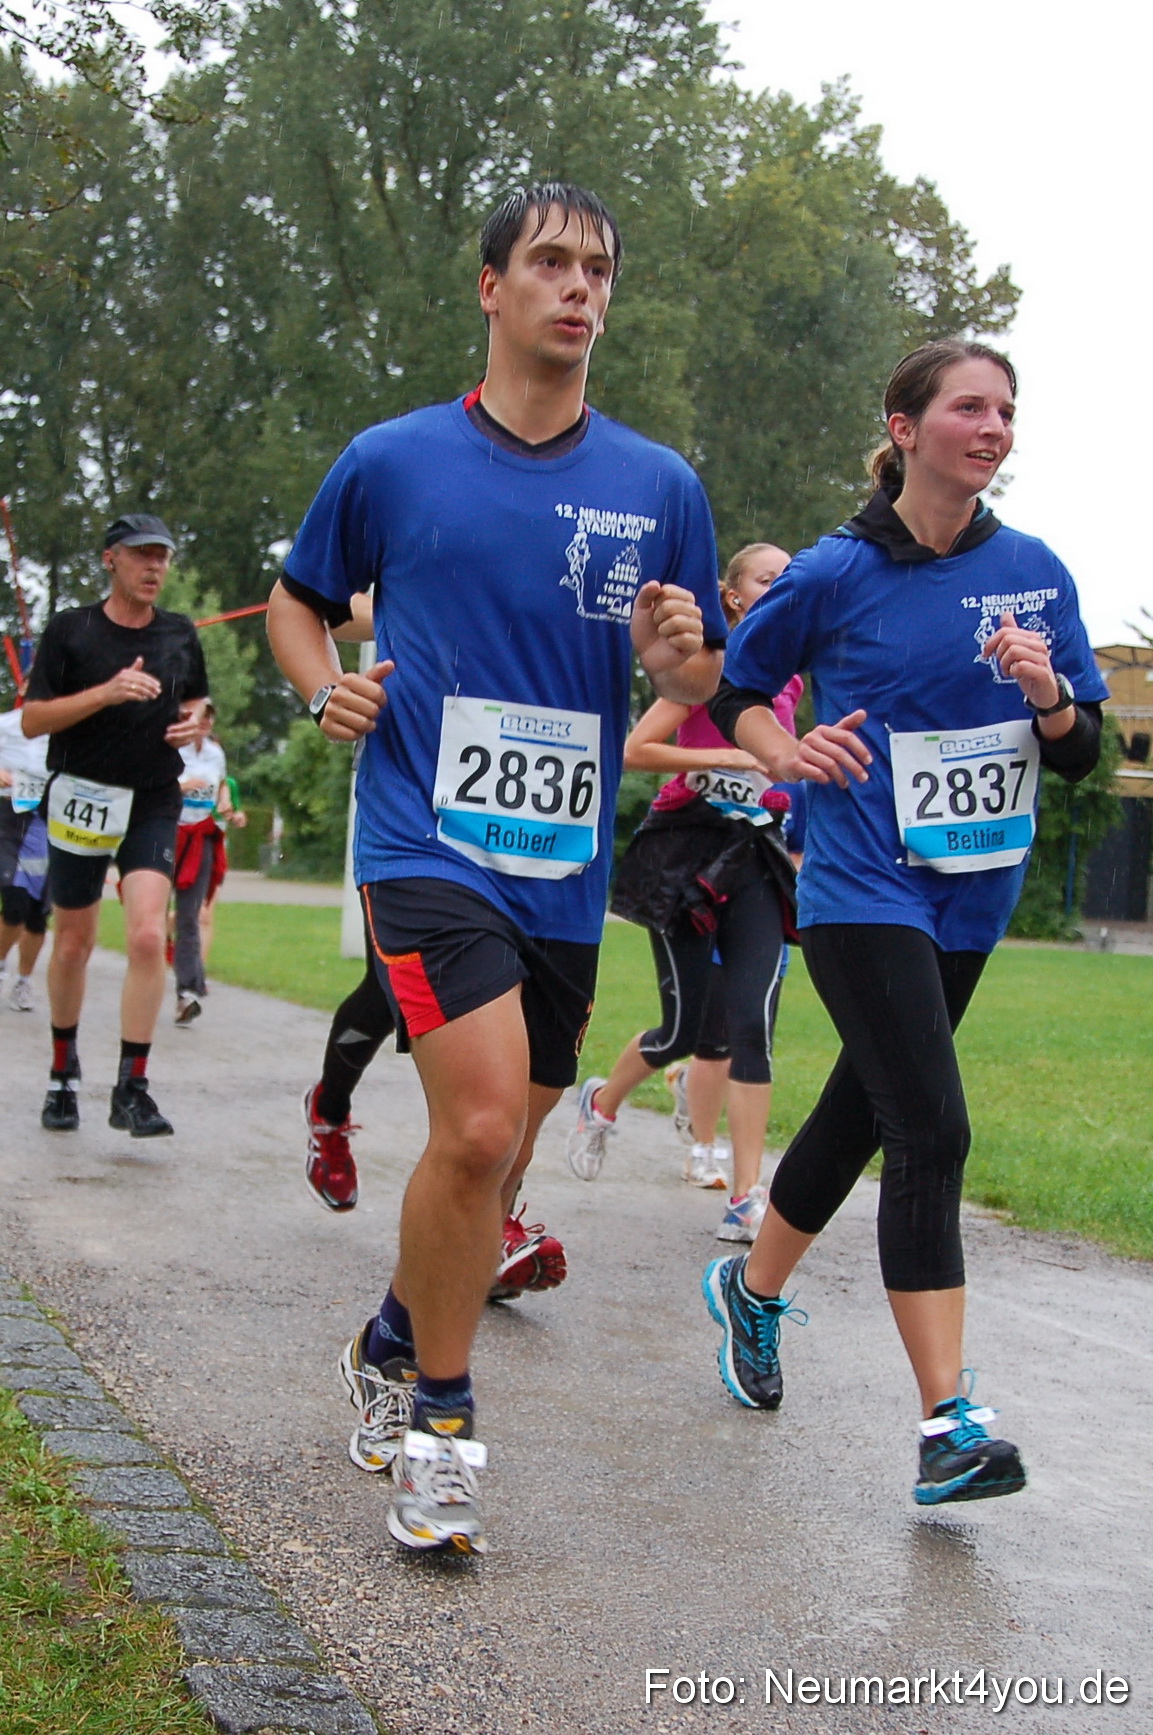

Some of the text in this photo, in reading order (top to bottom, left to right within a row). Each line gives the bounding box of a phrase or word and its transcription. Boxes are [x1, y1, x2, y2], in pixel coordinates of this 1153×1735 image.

[555, 503, 657, 533] 12. NEUMARKTER
[577, 519, 643, 542] STADTLAUF
[960, 597, 981, 609] 12.
[500, 714, 573, 739] BOCK
[939, 733, 1002, 754] BOCK
[454, 745, 597, 819] 2836
[912, 759, 1028, 820] 2837
[63, 798, 108, 831] 441
[484, 823, 557, 854] Robert
[946, 829, 1005, 851] Bettina
